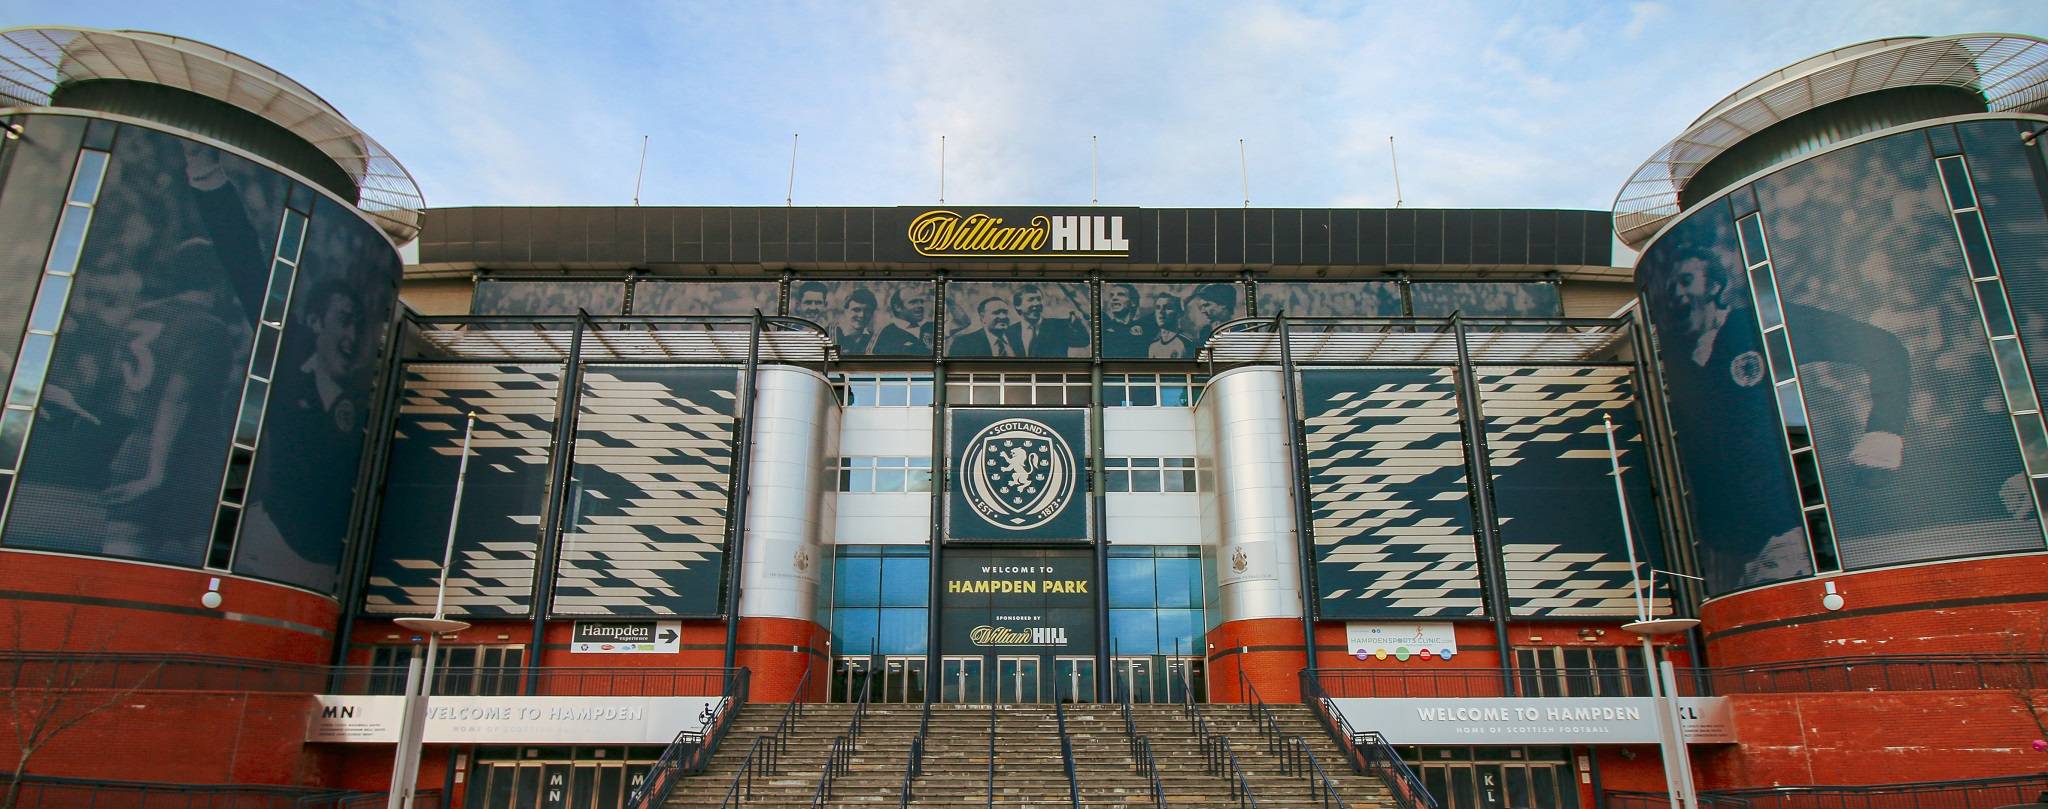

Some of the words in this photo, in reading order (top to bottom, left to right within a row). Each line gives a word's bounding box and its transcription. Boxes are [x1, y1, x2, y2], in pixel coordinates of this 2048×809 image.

[908, 210, 1051, 256] William
[1052, 215, 1129, 251] HILL
[994, 422, 1043, 435] SCOTLAND
[977, 501, 995, 516] EST
[1041, 501, 1060, 517] 1873
[981, 566, 1035, 574] WELCOME
[1039, 566, 1054, 574] TO
[948, 580, 1036, 593] HAMPDEN
[1042, 580, 1088, 593] PARK
[582, 624, 649, 639] Hampden
[970, 625, 1033, 647] William
[1033, 627, 1068, 644] HILL
[519, 705, 542, 721] TO
[549, 705, 643, 721] HAMPDEN
[1417, 707, 1509, 721] WELCOME
[1515, 707, 1540, 721] TO
[1547, 706, 1640, 721] HAMPDEN
[1506, 726, 1555, 734] SCOTTISH
